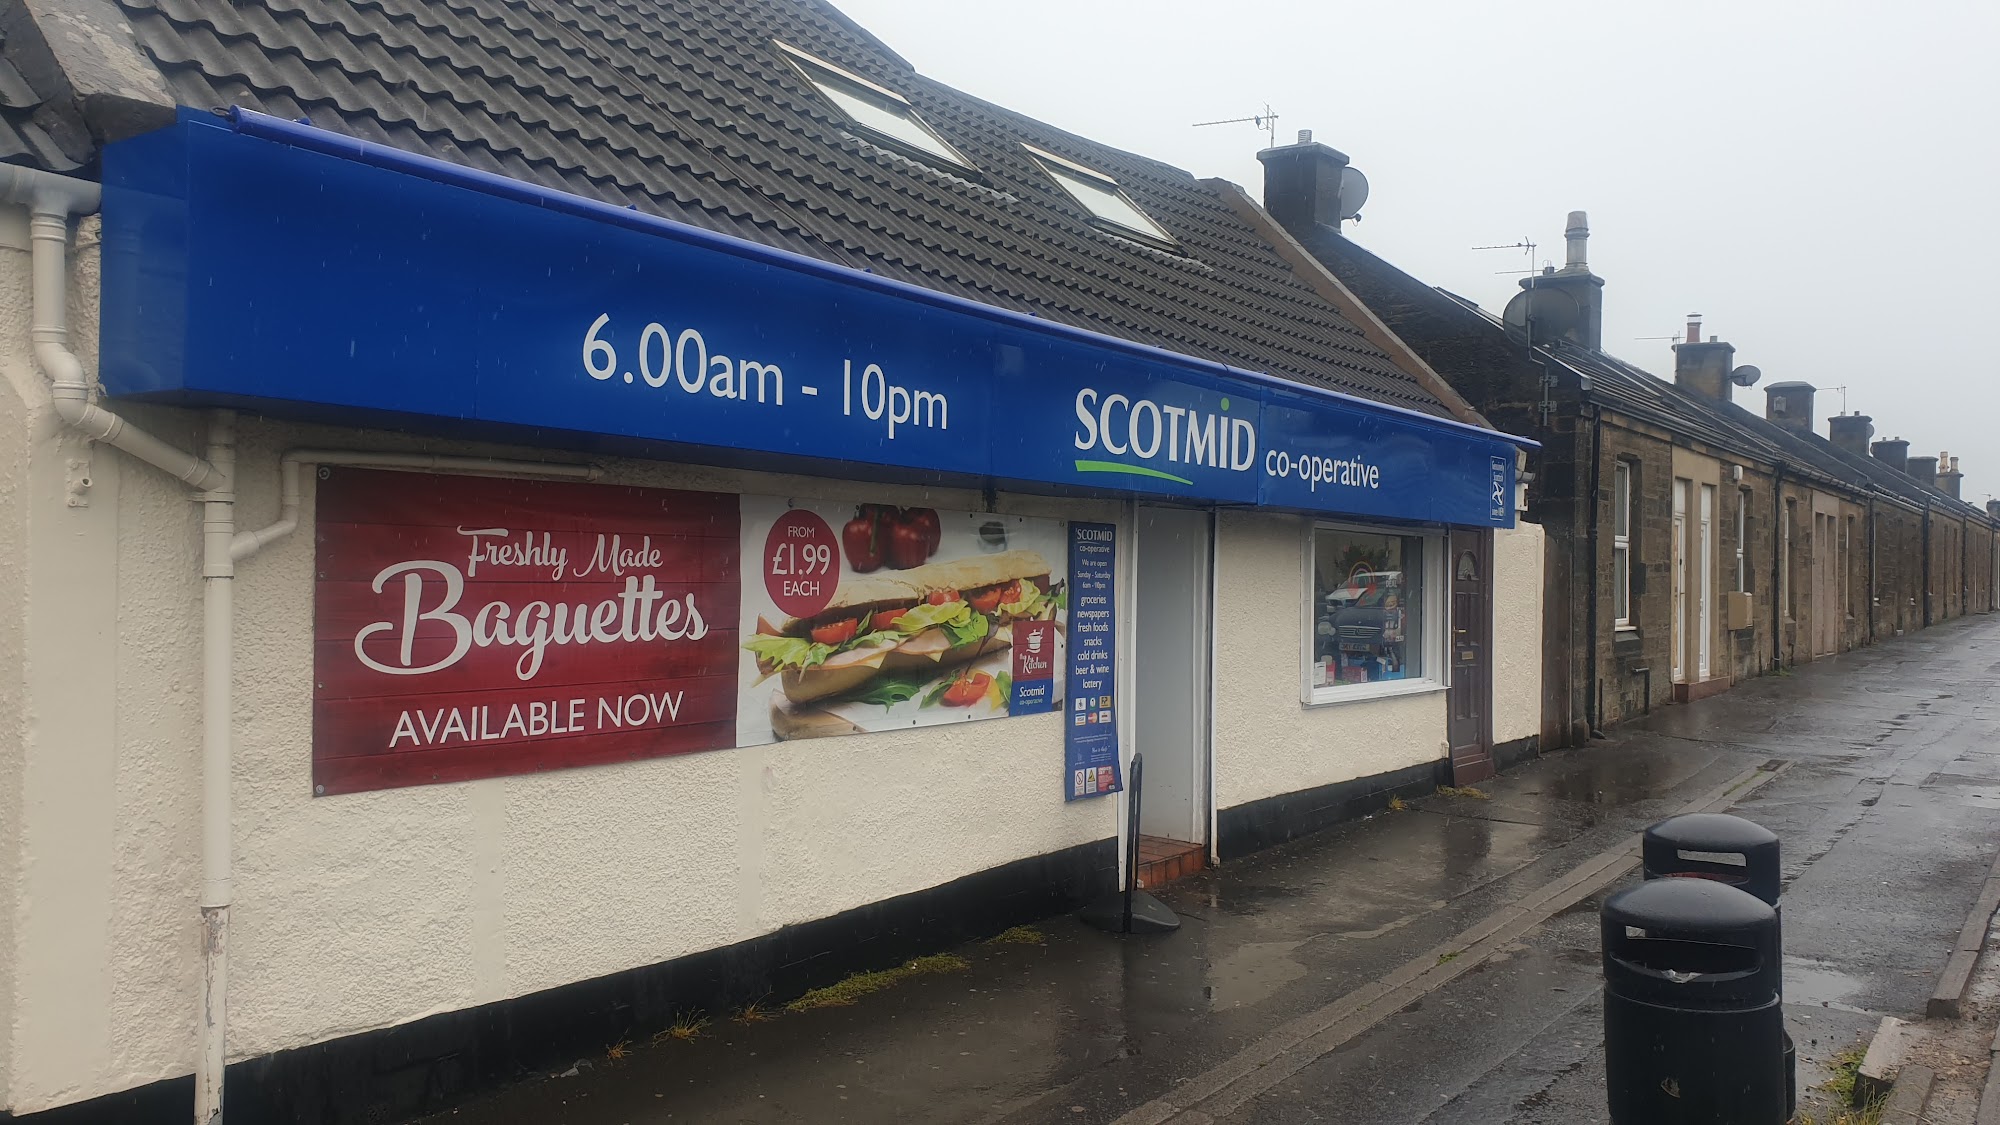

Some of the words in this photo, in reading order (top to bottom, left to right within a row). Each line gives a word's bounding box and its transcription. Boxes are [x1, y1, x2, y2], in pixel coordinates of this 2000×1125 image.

[583, 312, 783, 405] 6.00am
[802, 386, 818, 396] -
[843, 359, 947, 439] 10pm
[1265, 449, 1379, 492] co-operative
[788, 526, 815, 538] FROM
[456, 525, 568, 580] Freshly
[573, 534, 663, 577] Made
[1080, 545, 1110, 554] co-operative
[772, 543, 831, 575] £1.99
[1082, 559, 1089, 567] We
[783, 581, 820, 596] EACH
[1081, 595, 1107, 606] groceries
[354, 559, 708, 680] Baguettes
[1077, 610, 1110, 620] newspapers
[1077, 622, 1092, 632] fresh
[1093, 621, 1109, 632] foods
[1084, 636, 1102, 646] snacks
[1077, 650, 1090, 660] cold
[1091, 650, 1108, 660] drinks
[1023, 655, 1047, 674] Kitchen
[1075, 665, 1089, 675] beer
[1090, 664, 1095, 674] &
[1096, 664, 1109, 673] wine
[1082, 679, 1102, 690] lottery
[1019, 685, 1045, 697] Scotmid
[389, 698, 585, 748] AVAILABLE
[597, 691, 683, 729] NOW
